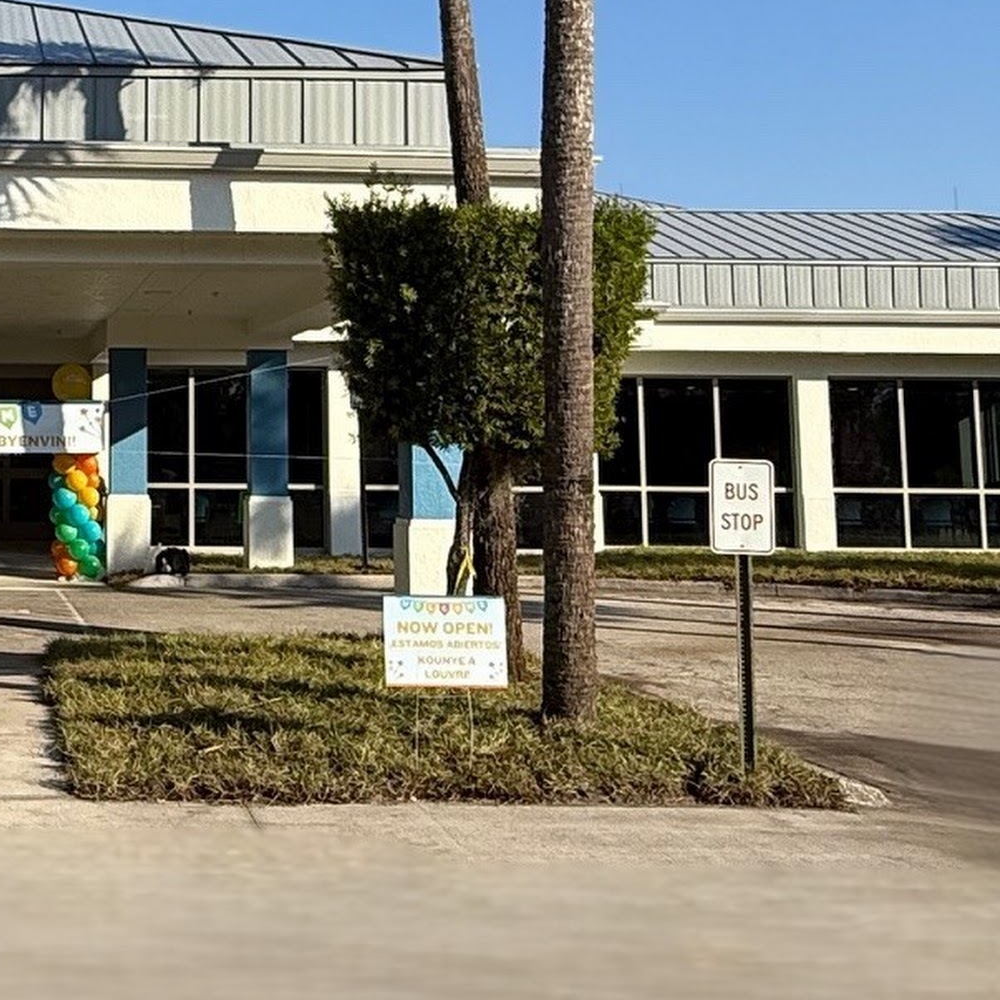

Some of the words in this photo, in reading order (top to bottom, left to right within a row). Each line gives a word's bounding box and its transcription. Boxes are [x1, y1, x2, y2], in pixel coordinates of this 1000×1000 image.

[725, 482, 759, 501] BUS
[721, 512, 764, 531] STOP
[397, 621, 438, 634] NOW
[442, 621, 493, 635] OPEN!
